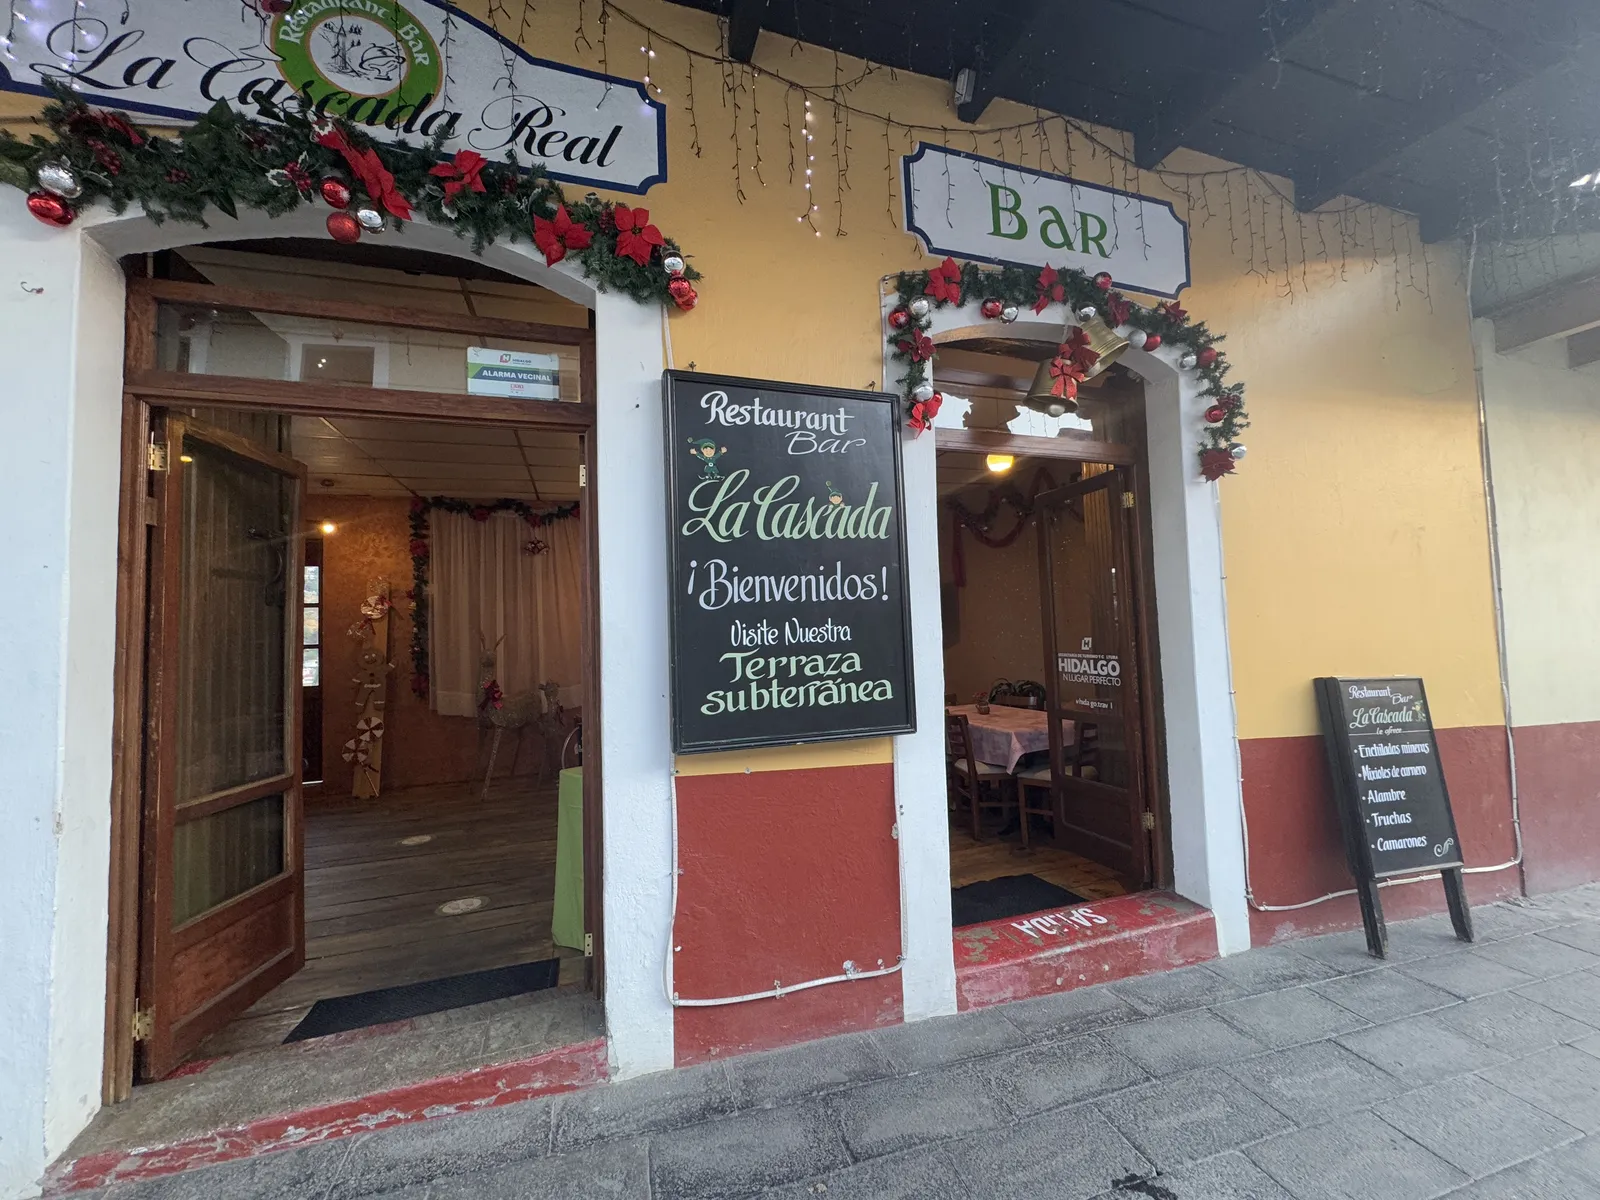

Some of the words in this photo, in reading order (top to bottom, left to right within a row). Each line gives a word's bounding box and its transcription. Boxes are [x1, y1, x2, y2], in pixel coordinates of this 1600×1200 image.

[29, 16, 174, 91] La
[467, 95, 623, 168] Real
[482, 369, 516, 379] ALARMA
[518, 372, 551, 382] VECINAL
[700, 390, 855, 435] Restaurant
[784, 431, 866, 455] Bar
[682, 469, 750, 542] La
[753, 475, 892, 541] Cascada
[687, 558, 889, 610] ¡Bienvenidos!
[731, 618, 779, 647] Visite
[785, 618, 852, 646] Nuestra
[719, 649, 863, 683] Terraza
[1058, 657, 1120, 676] HIDALGO
[1068, 674, 1090, 683] LUGAR
[1090, 675, 1121, 686] PERFECTO
[1349, 685, 1392, 700] Restaurant
[1391, 692, 1413, 705] Bar
[1349, 707, 1369, 728] La
[1369, 705, 1413, 724] Cascada
[1358, 743, 1400, 758] Enchiladas
[1401, 742, 1429, 754] mineras
[1392, 765, 1400, 777] de
[1401, 765, 1427, 777] carnero
[1368, 788, 1406, 804] Alambre
[1371, 811, 1412, 827] Truchas
[1377, 835, 1427, 851] Camarones
